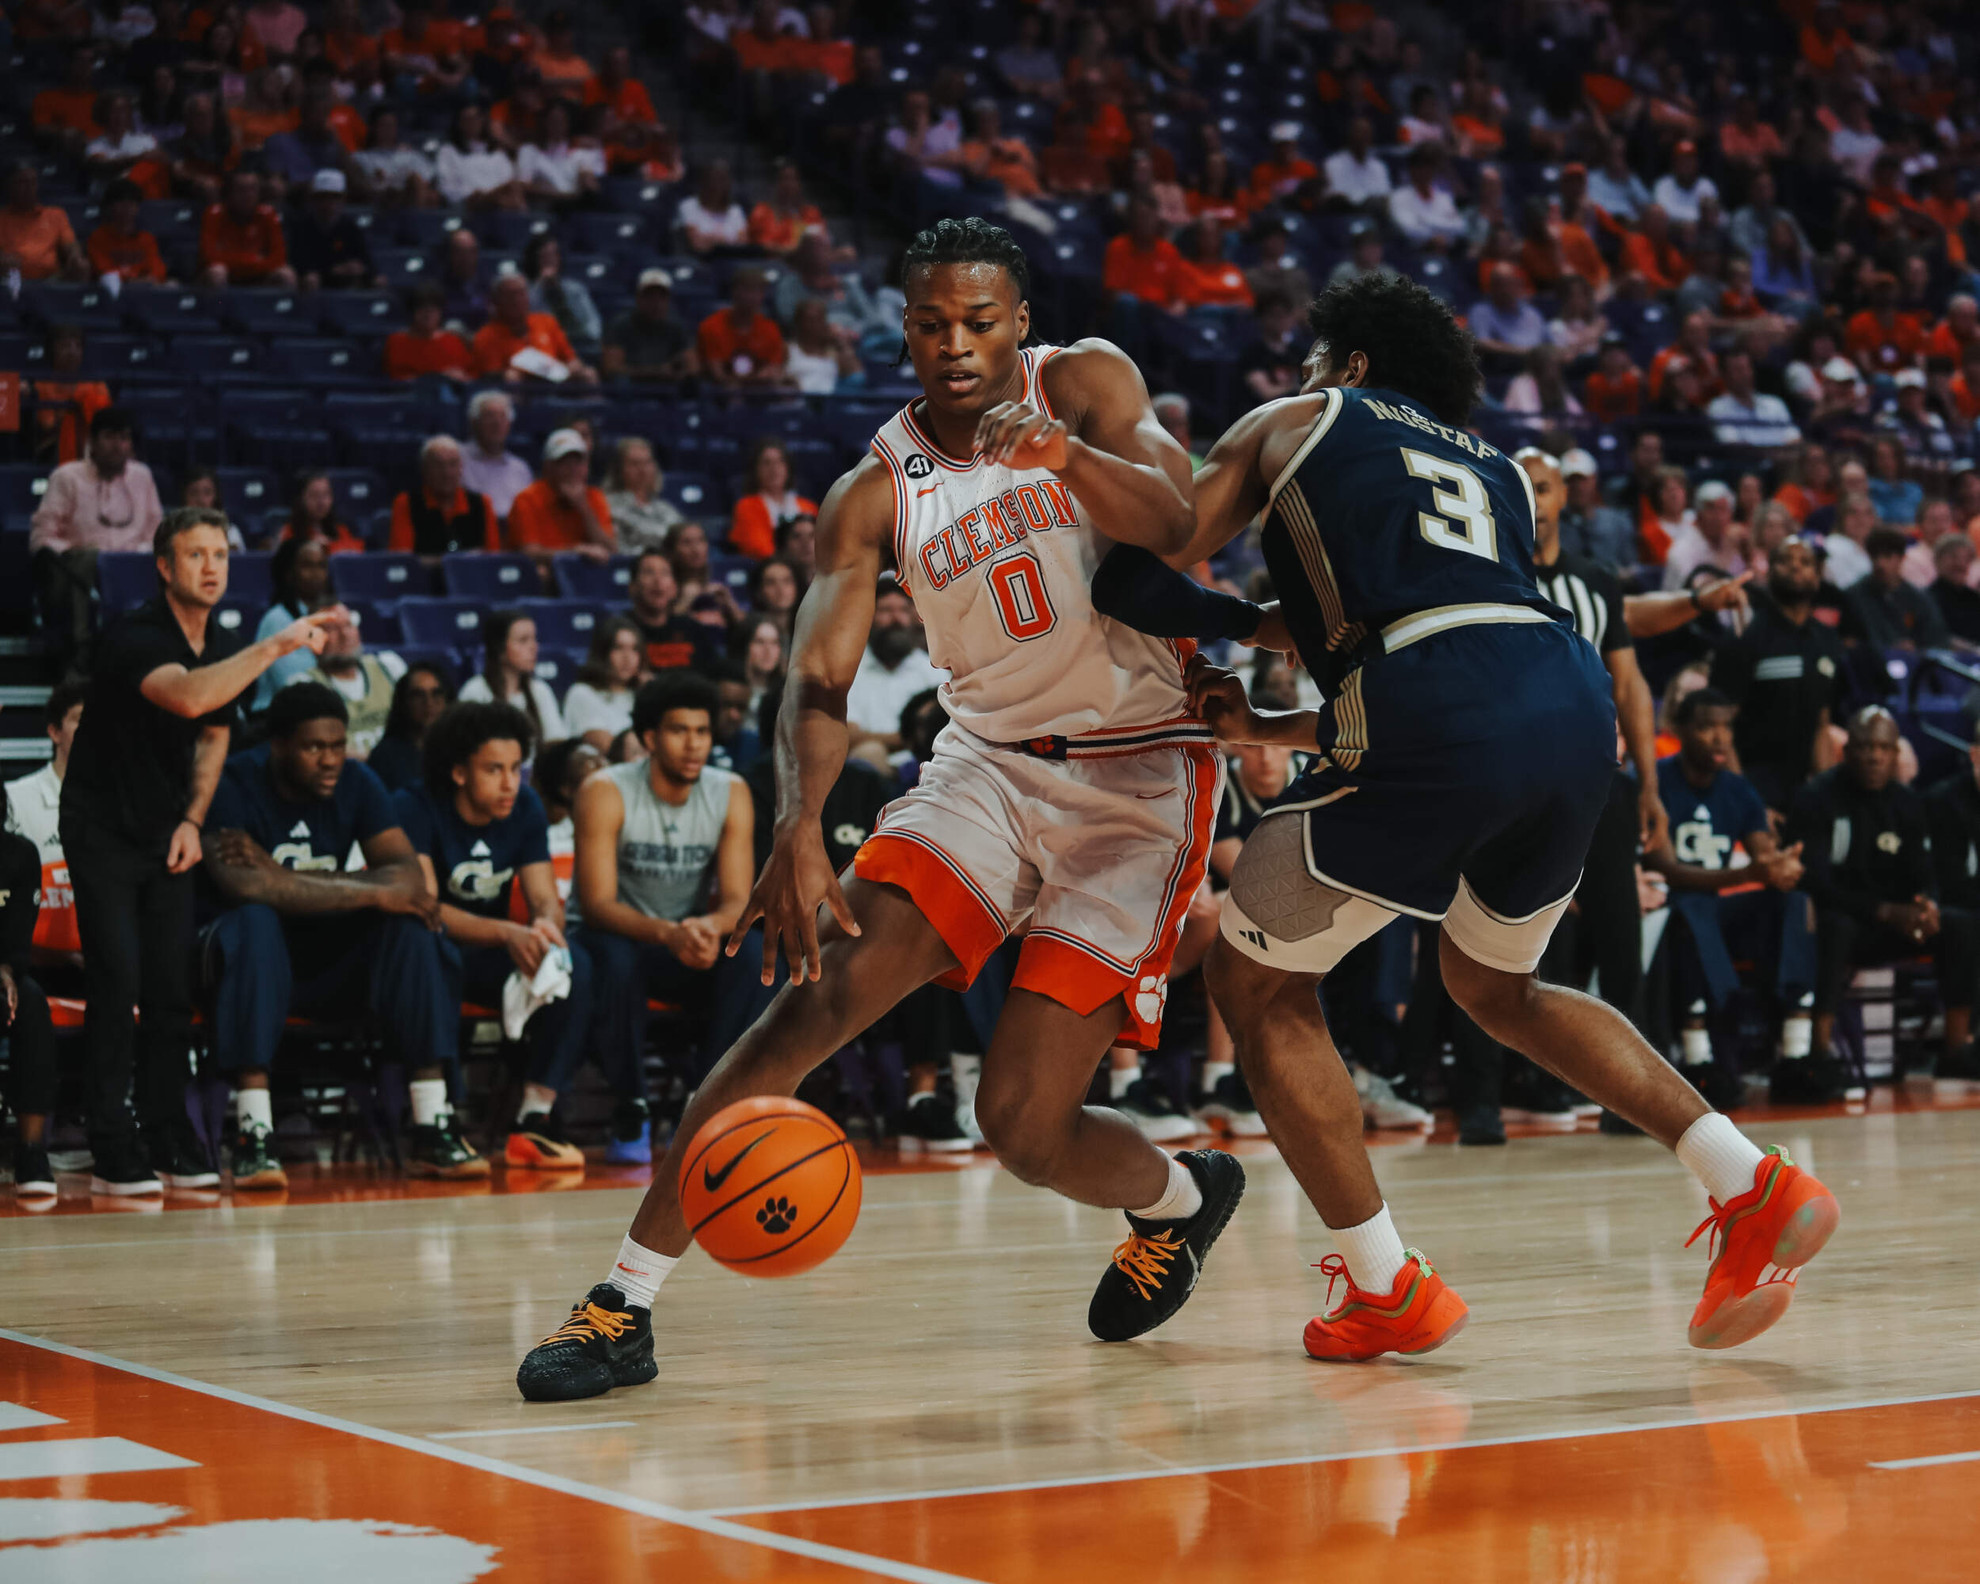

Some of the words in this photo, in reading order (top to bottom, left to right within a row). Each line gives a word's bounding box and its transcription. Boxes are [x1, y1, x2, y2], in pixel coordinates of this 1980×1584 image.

[907, 456, 931, 475] 41
[1400, 446, 1500, 563] 3
[919, 479, 1080, 591] CLEMSON
[986, 551, 1058, 643] 0
